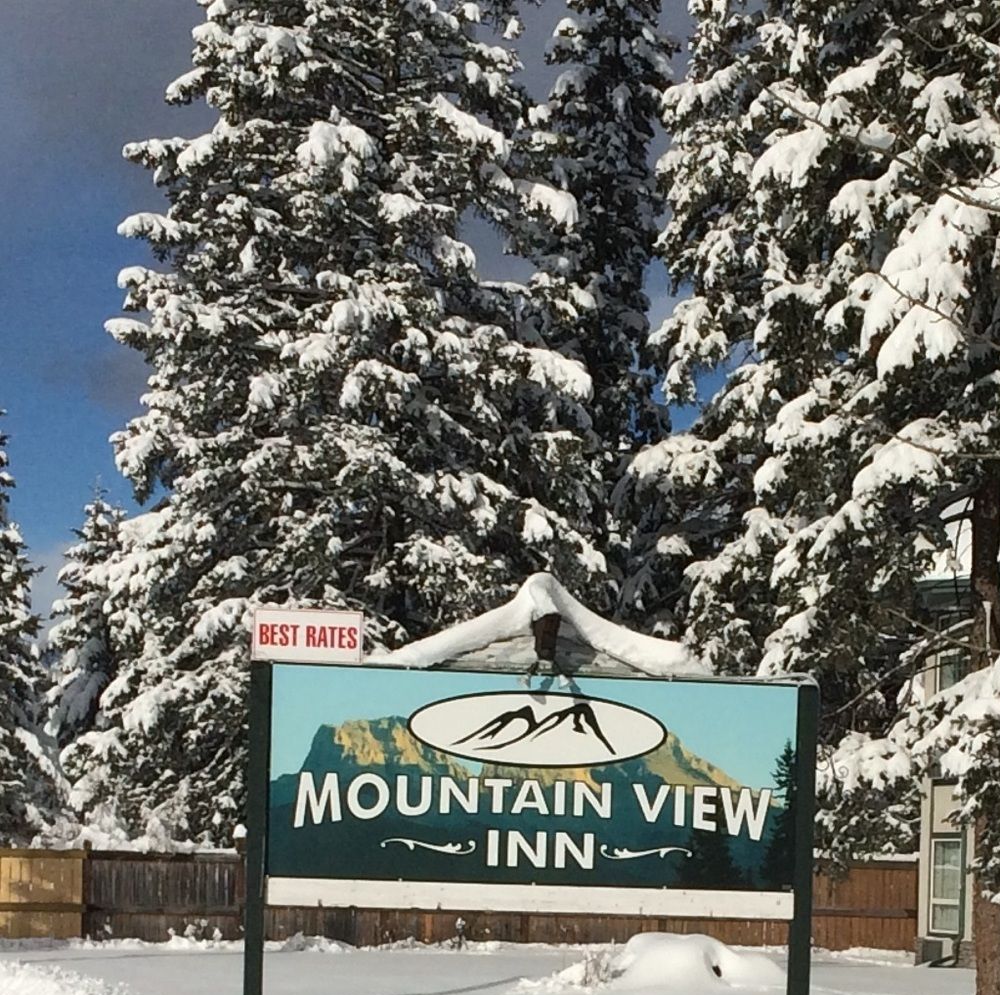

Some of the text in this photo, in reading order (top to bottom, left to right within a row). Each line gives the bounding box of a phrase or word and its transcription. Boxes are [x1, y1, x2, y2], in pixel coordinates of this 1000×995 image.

[259, 624, 358, 649] BEST RATES
[294, 772, 772, 841] MOUNTAIN VIEW
[487, 829, 595, 870] INN
